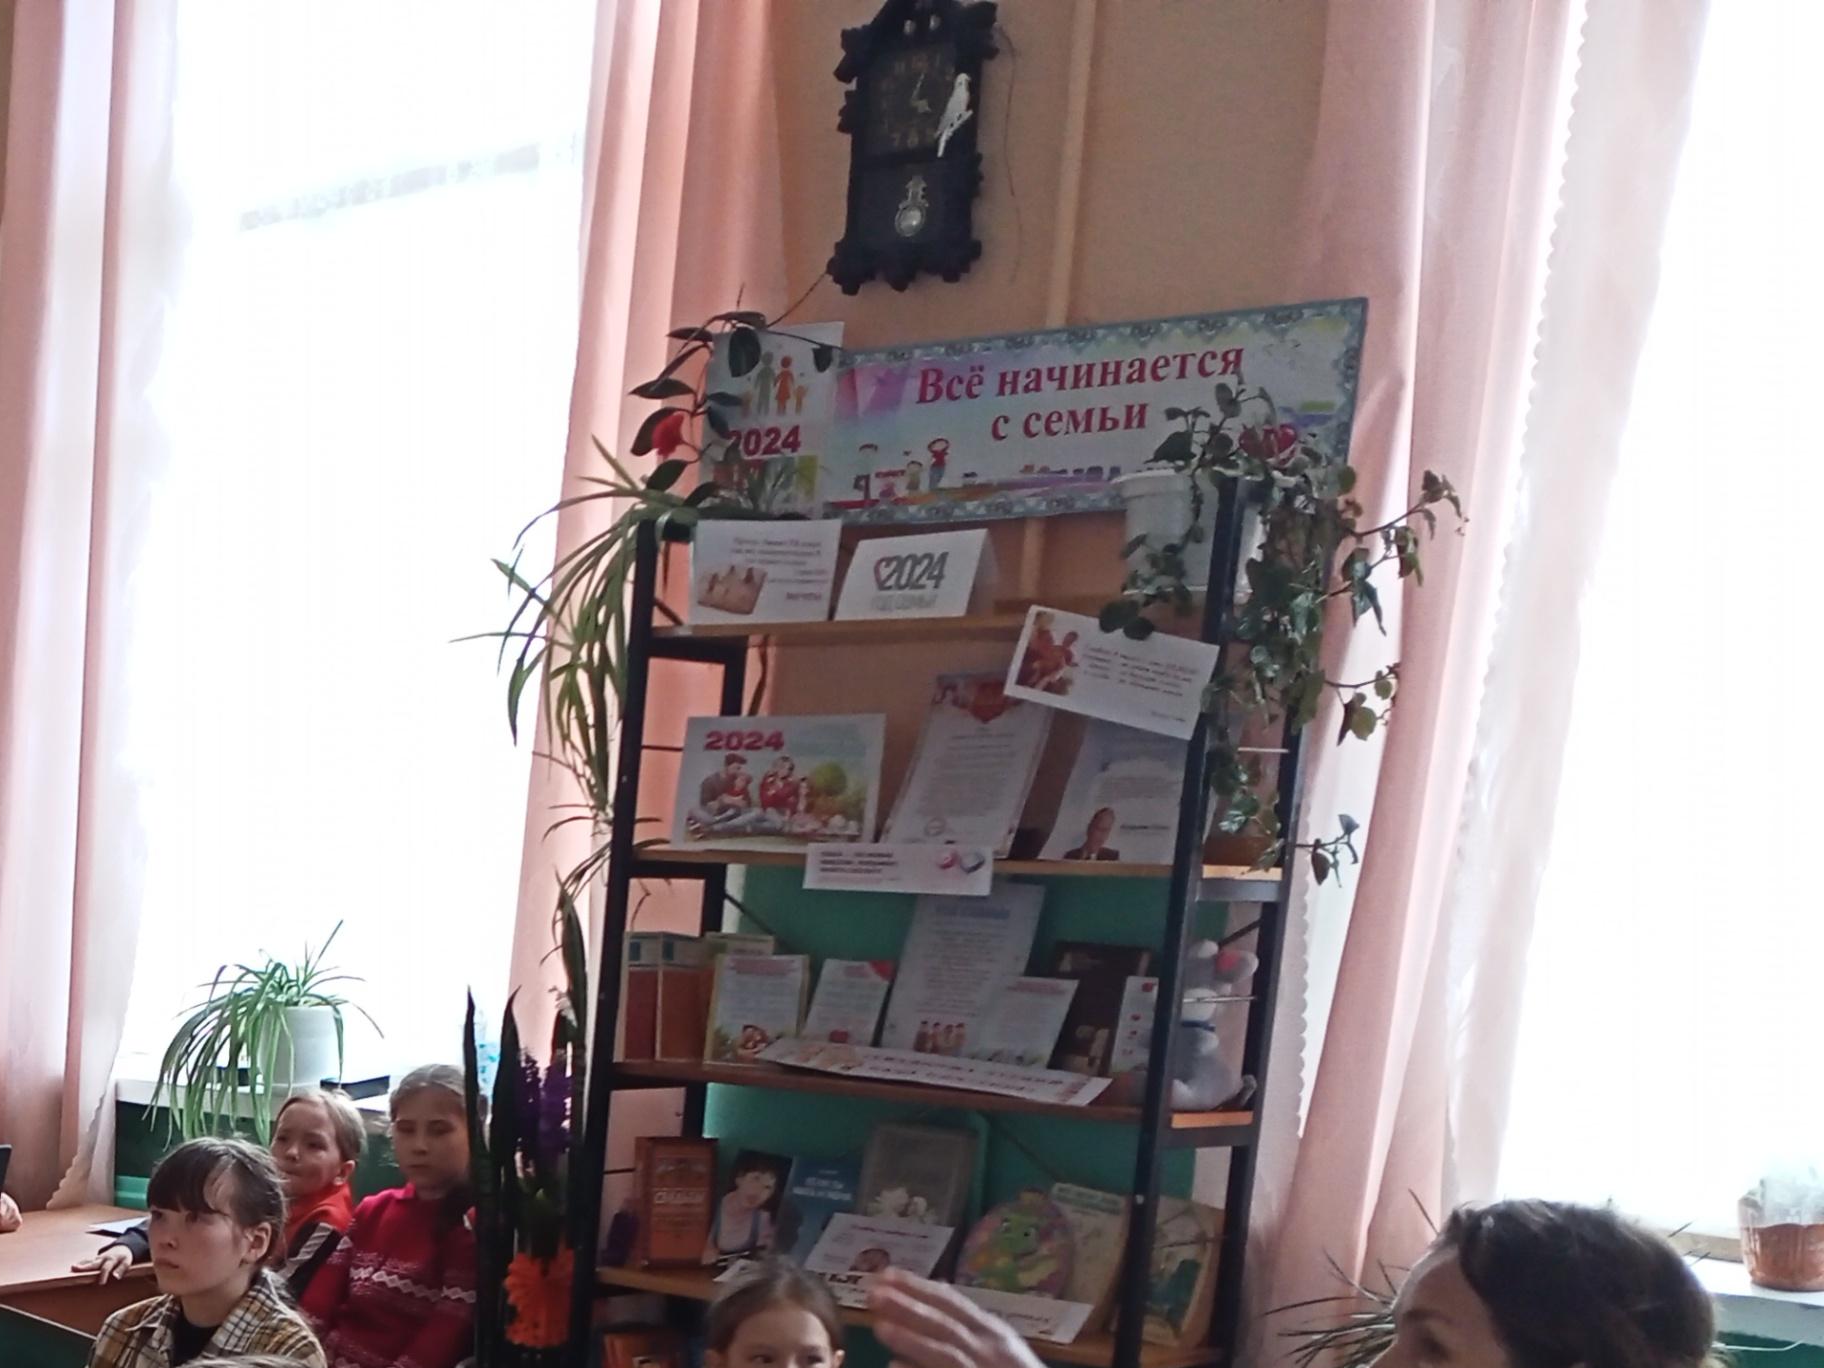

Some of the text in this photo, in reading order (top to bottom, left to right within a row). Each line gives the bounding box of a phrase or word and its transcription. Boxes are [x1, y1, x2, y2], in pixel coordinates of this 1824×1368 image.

[916, 348, 1245, 404] Всё начинается
[728, 424, 802, 457] 2024
[991, 402, 1150, 442] с семьи
[880, 551, 949, 591] 2024
[704, 730, 785, 751] 2024
